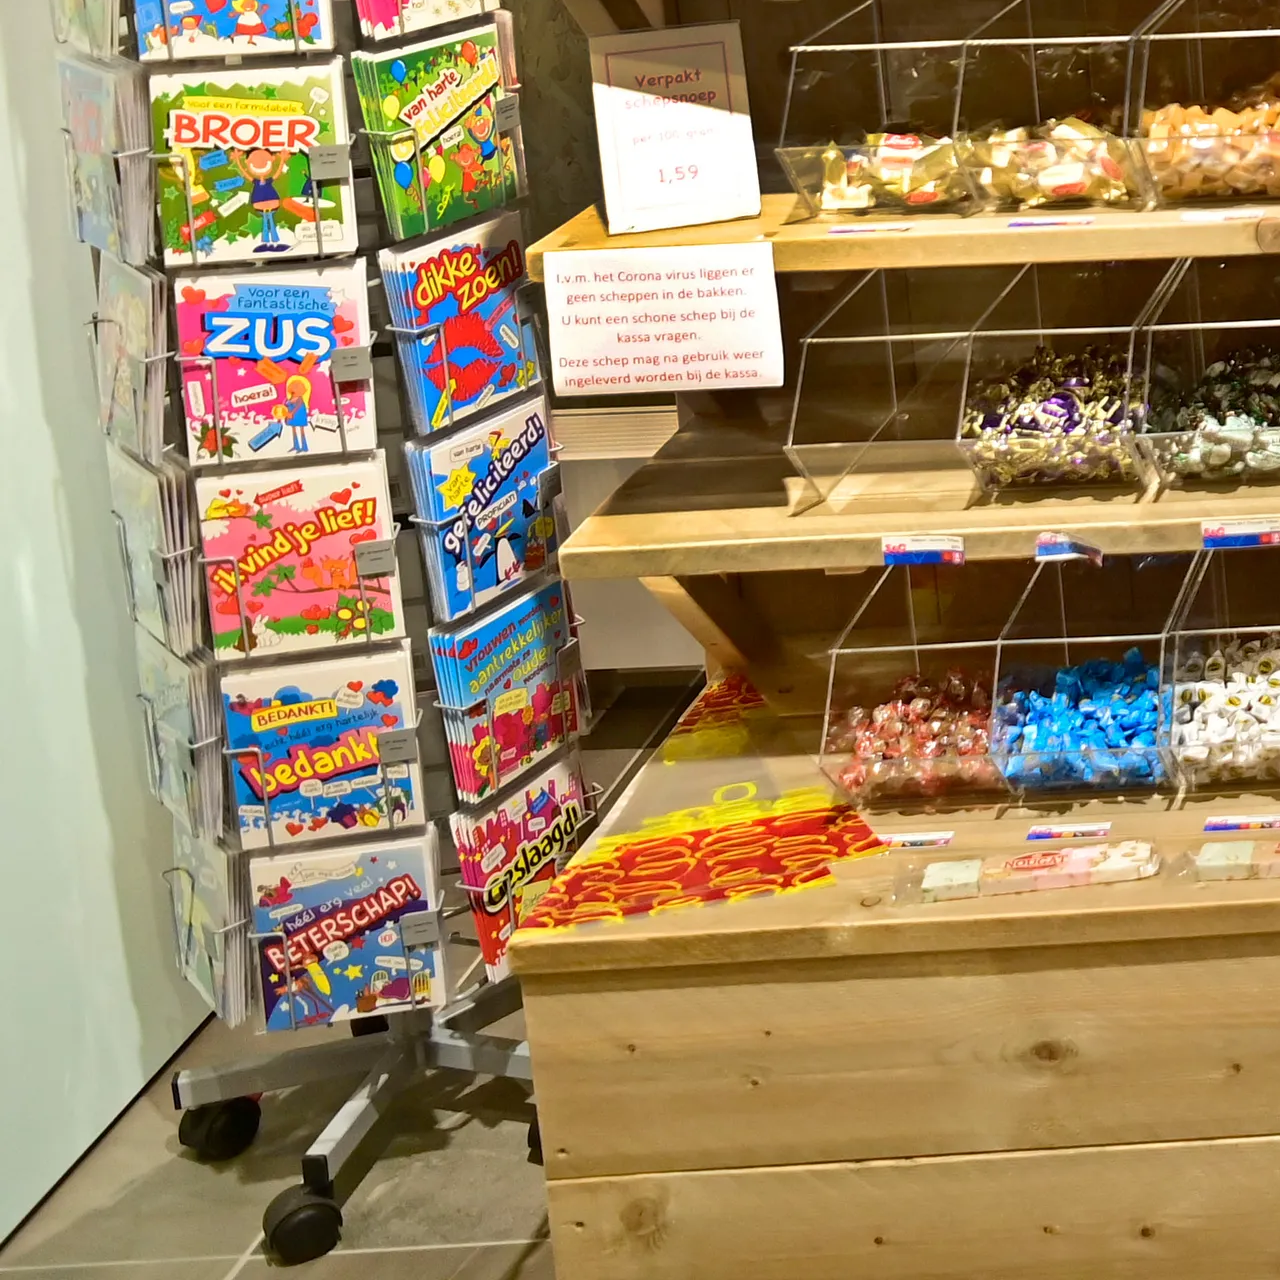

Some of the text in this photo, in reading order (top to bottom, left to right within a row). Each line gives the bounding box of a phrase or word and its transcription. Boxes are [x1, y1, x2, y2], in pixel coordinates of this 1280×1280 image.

[635, 69, 702, 88] Verpakt
[404, 71, 458, 120] van harte
[625, 89, 717, 110] schepsnoep
[214, 101, 297, 113] een formidabele
[174, 114, 315, 148] BROER
[659, 165, 699, 184] 1,59
[416, 252, 476, 307] dikke
[457, 246, 519, 311] zoen!
[556, 267, 754, 284] I.v.m. het Corona virus liggen er
[237, 298, 329, 311] fantastische
[284, 289, 310, 299] een
[566, 287, 747, 305] geen scheppen in de bakken.
[562, 308, 755, 325] U kunt een schone schep bij de
[206, 317, 330, 357] ZUS
[617, 332, 701, 343] kassa vragen.
[559, 349, 764, 368] Deze schep mag na gebruik weer
[565, 367, 762, 388] ingeleverd worden bij de kassa.
[234, 387, 274, 404] hoera!
[444, 414, 544, 553] gefeliciteerd!
[446, 473, 462, 492] van
[449, 475, 470, 502] harte
[213, 501, 374, 594] ik vind je lief!
[465, 622, 516, 672] vrouwen
[469, 608, 562, 694] aantrekkelijker
[513, 645, 553, 681] ouder
[257, 701, 334, 727] BEDANKT!
[315, 721, 333, 735] erg
[1005, 854, 1068, 868] NOUGAT
[286, 876, 373, 930] héél erg veel
[267, 880, 415, 971] BETERSCHAP!
